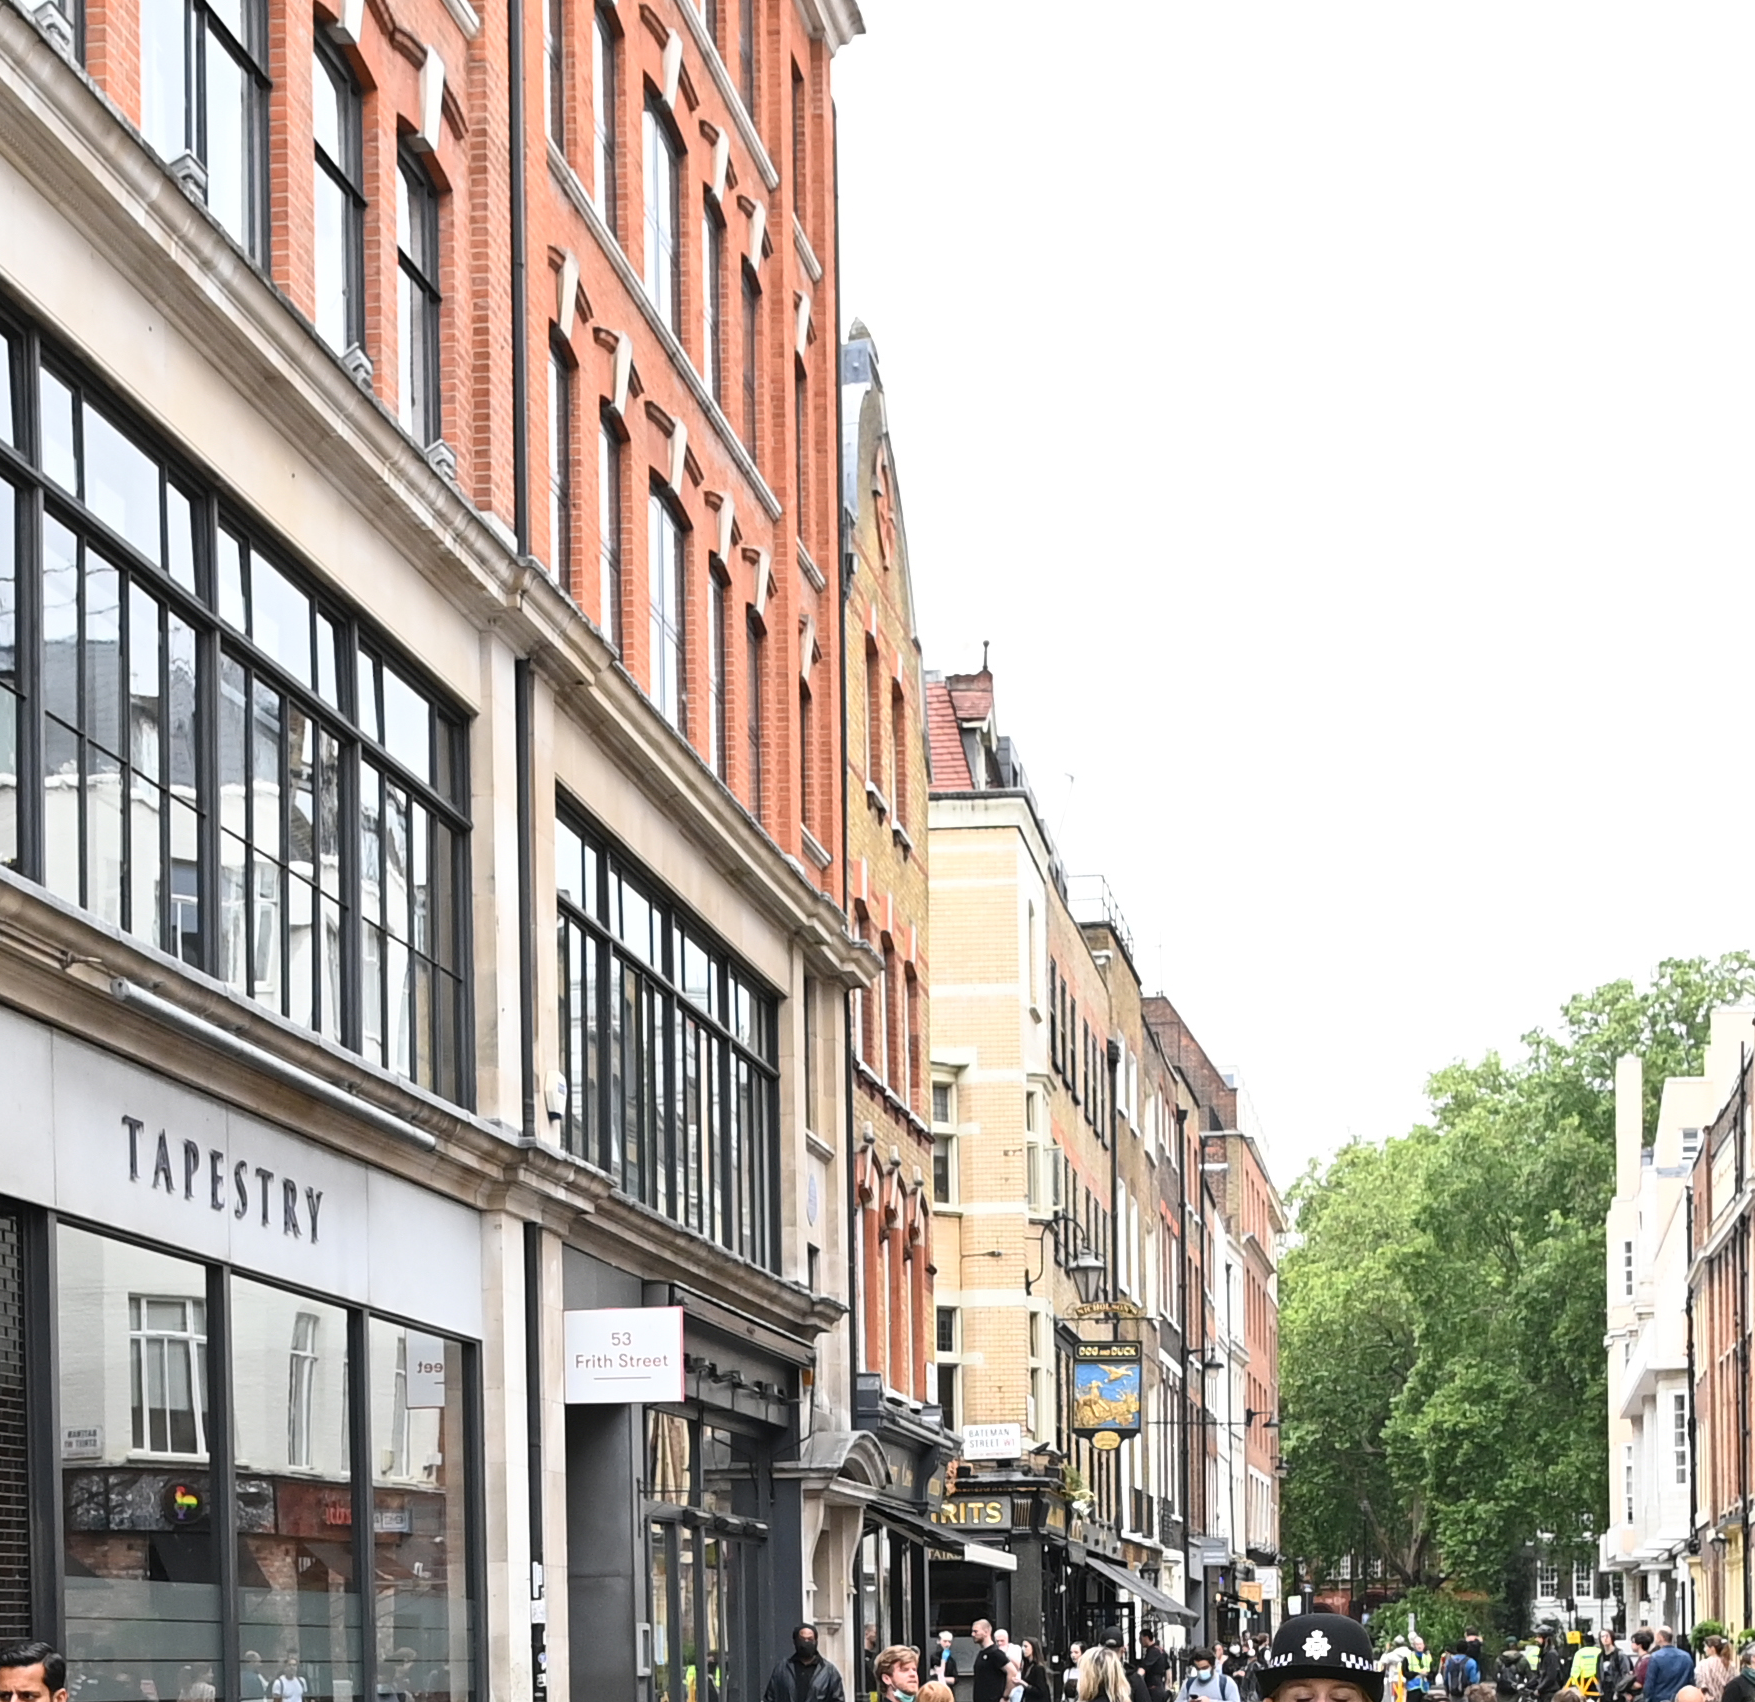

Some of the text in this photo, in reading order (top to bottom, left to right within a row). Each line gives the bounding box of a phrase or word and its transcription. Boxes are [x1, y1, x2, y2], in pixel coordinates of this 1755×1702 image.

[121, 1114, 324, 1245] TAPESTRY
[610, 1331, 632, 1346] 53
[575, 1353, 669, 1369] Frith Street
[968, 1428, 1010, 1438] BATEMAN
[969, 1438, 999, 1449] STREET
